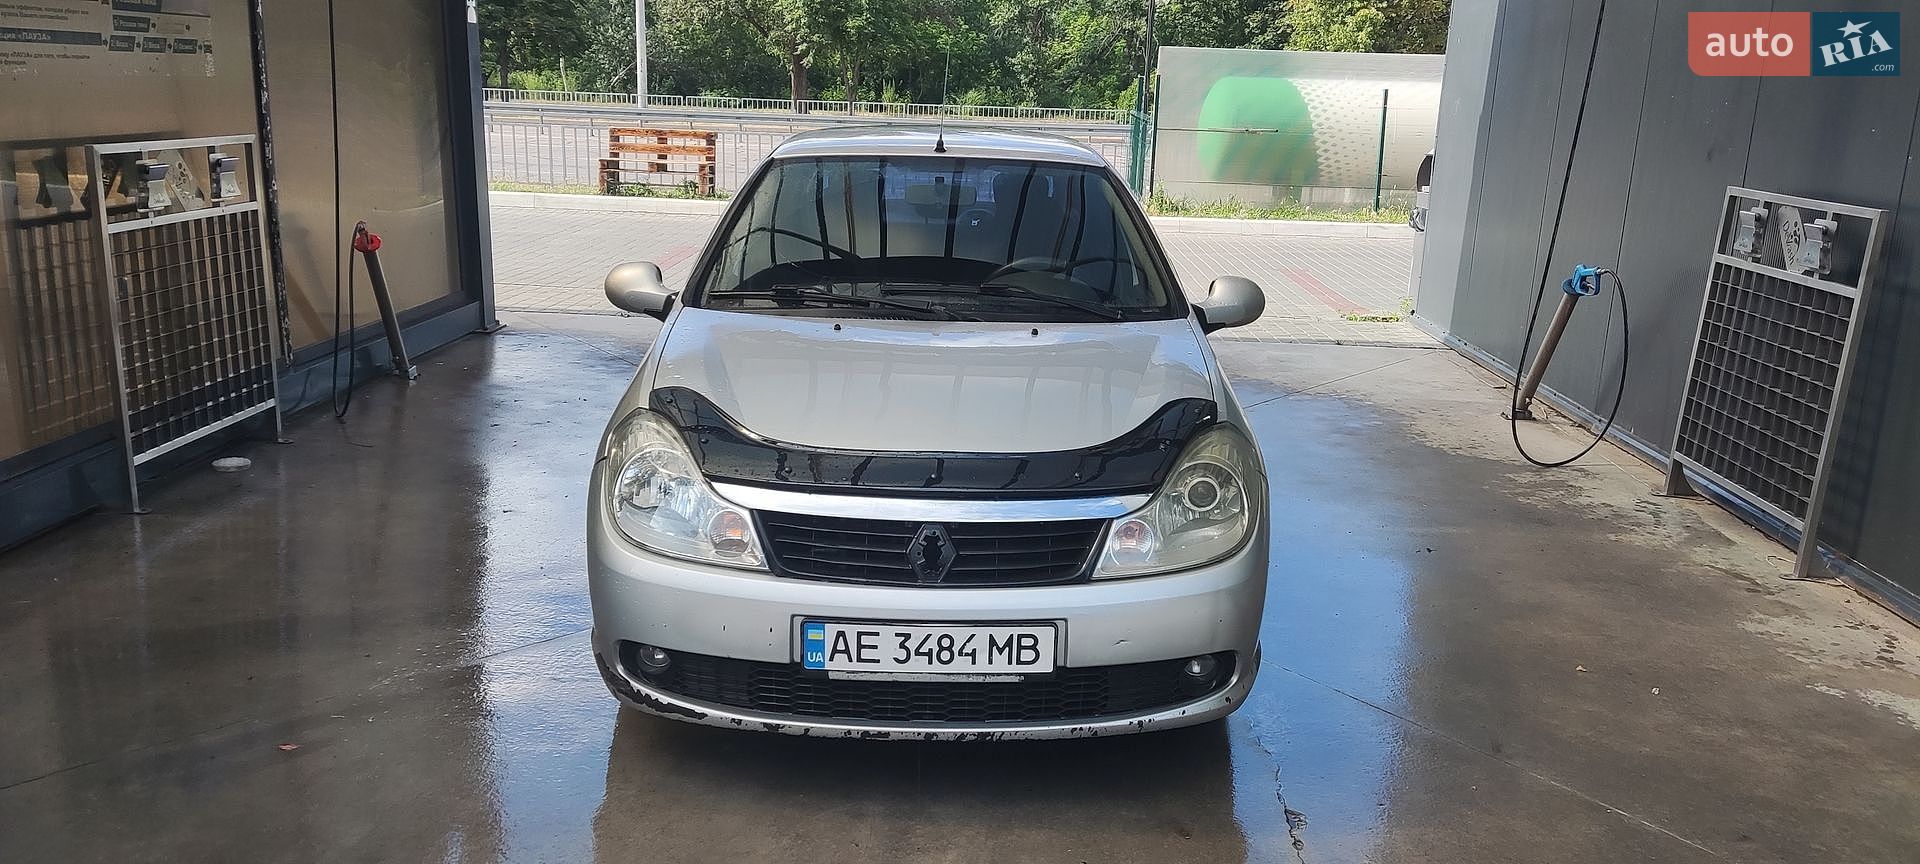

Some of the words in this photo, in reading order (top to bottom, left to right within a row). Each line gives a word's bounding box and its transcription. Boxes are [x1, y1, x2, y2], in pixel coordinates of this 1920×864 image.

[807, 651, 824, 663] UA
[828, 630, 881, 664] AE
[892, 632, 977, 666] 3484
[987, 633, 1041, 666] MB
